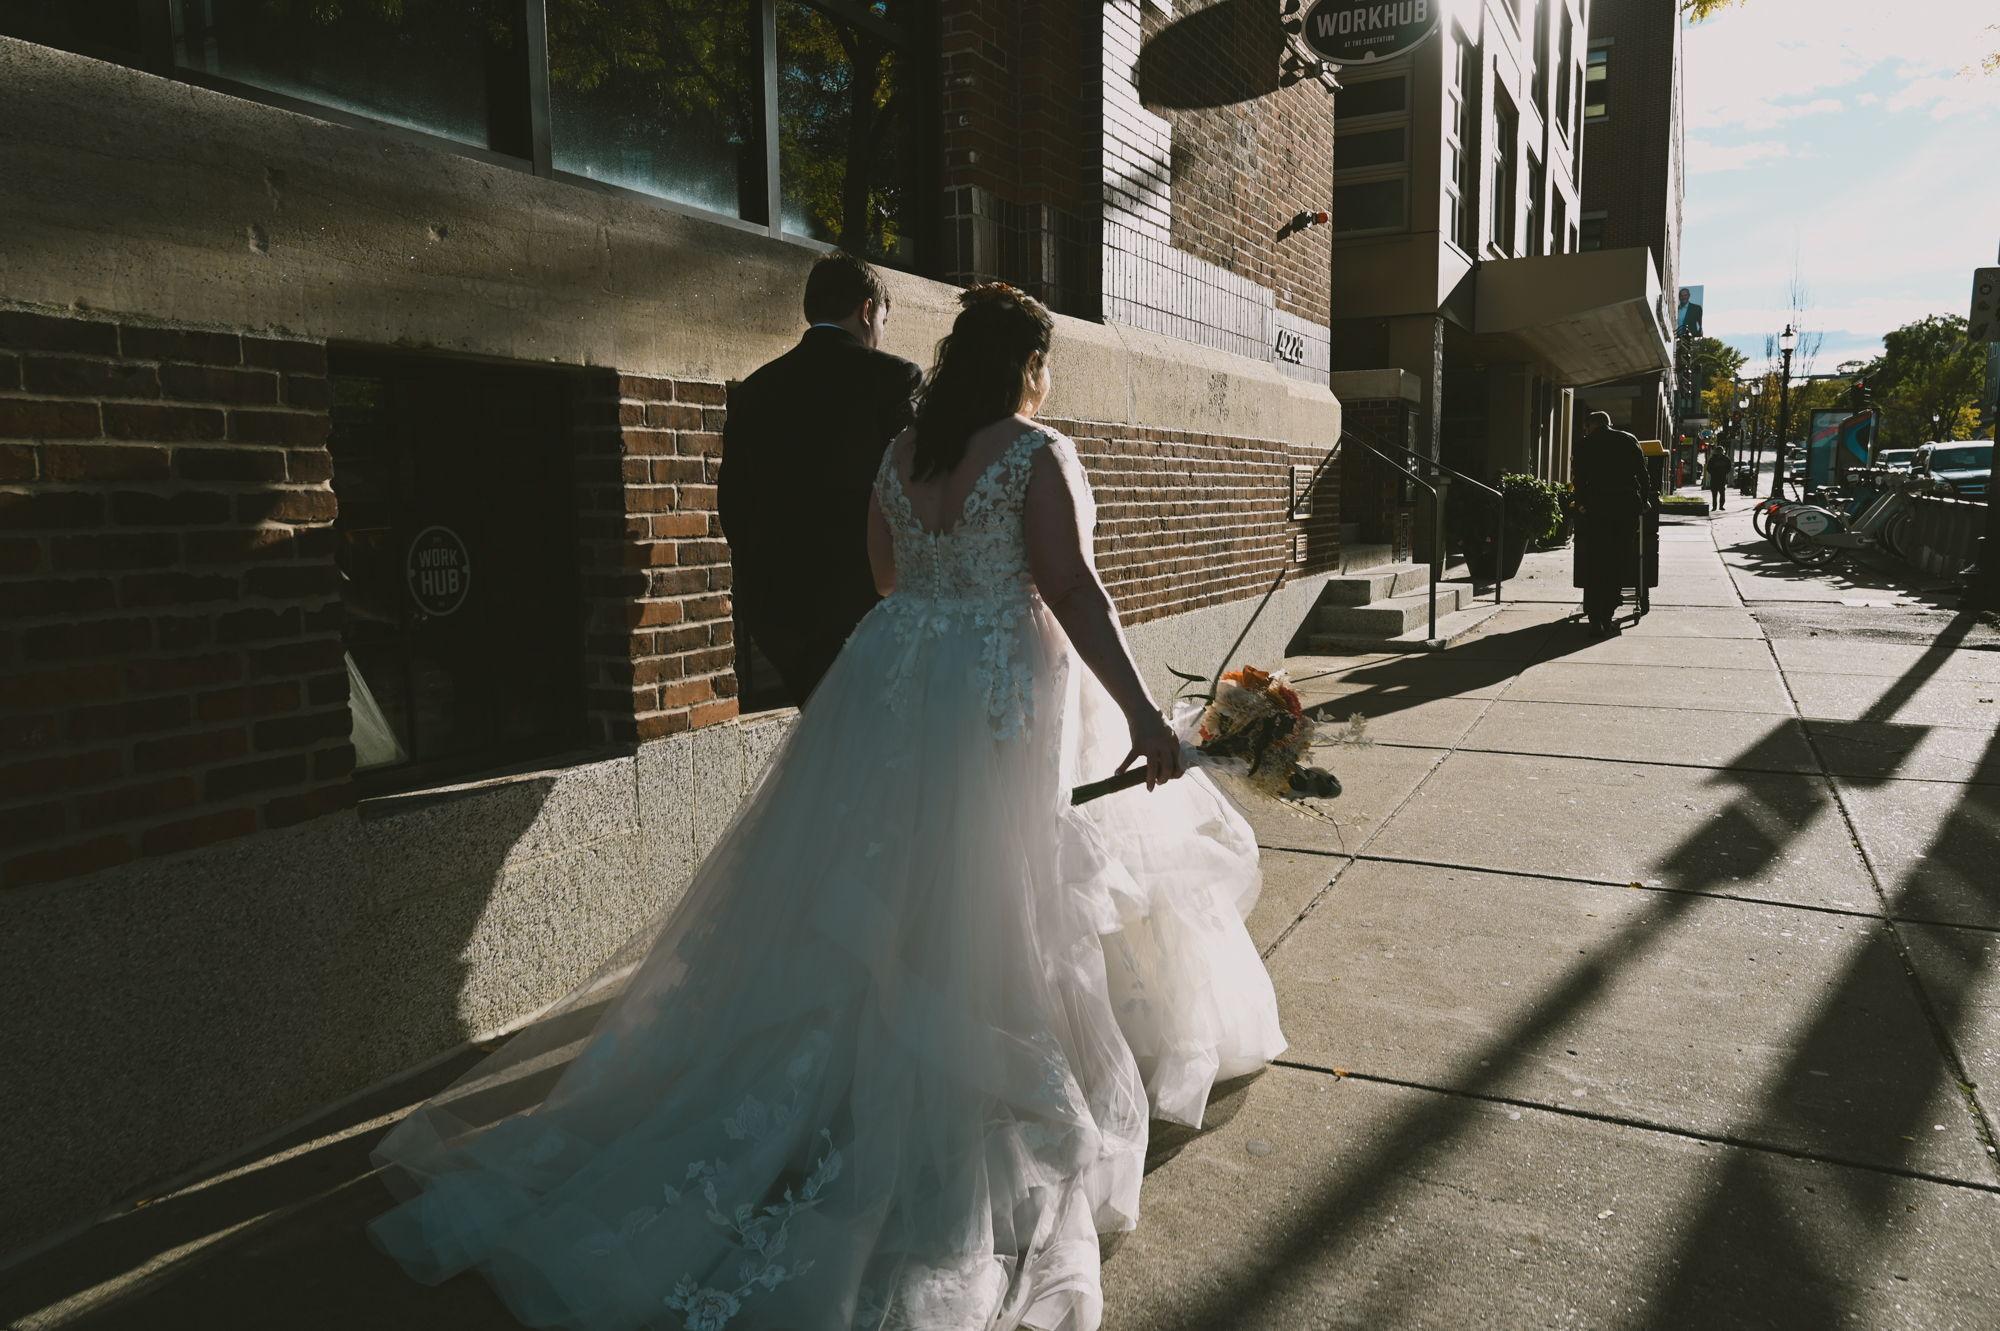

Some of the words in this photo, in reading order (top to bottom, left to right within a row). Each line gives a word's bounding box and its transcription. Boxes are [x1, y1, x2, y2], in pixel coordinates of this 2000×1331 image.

[1317, 0, 1427, 38] WORKHUB
[1344, 40, 1351, 48] AT
[1352, 39, 1361, 47] THE
[1363, 34, 1395, 45] SUBSTATION
[419, 548, 458, 568] WORK
[421, 569, 459, 595] HUB
